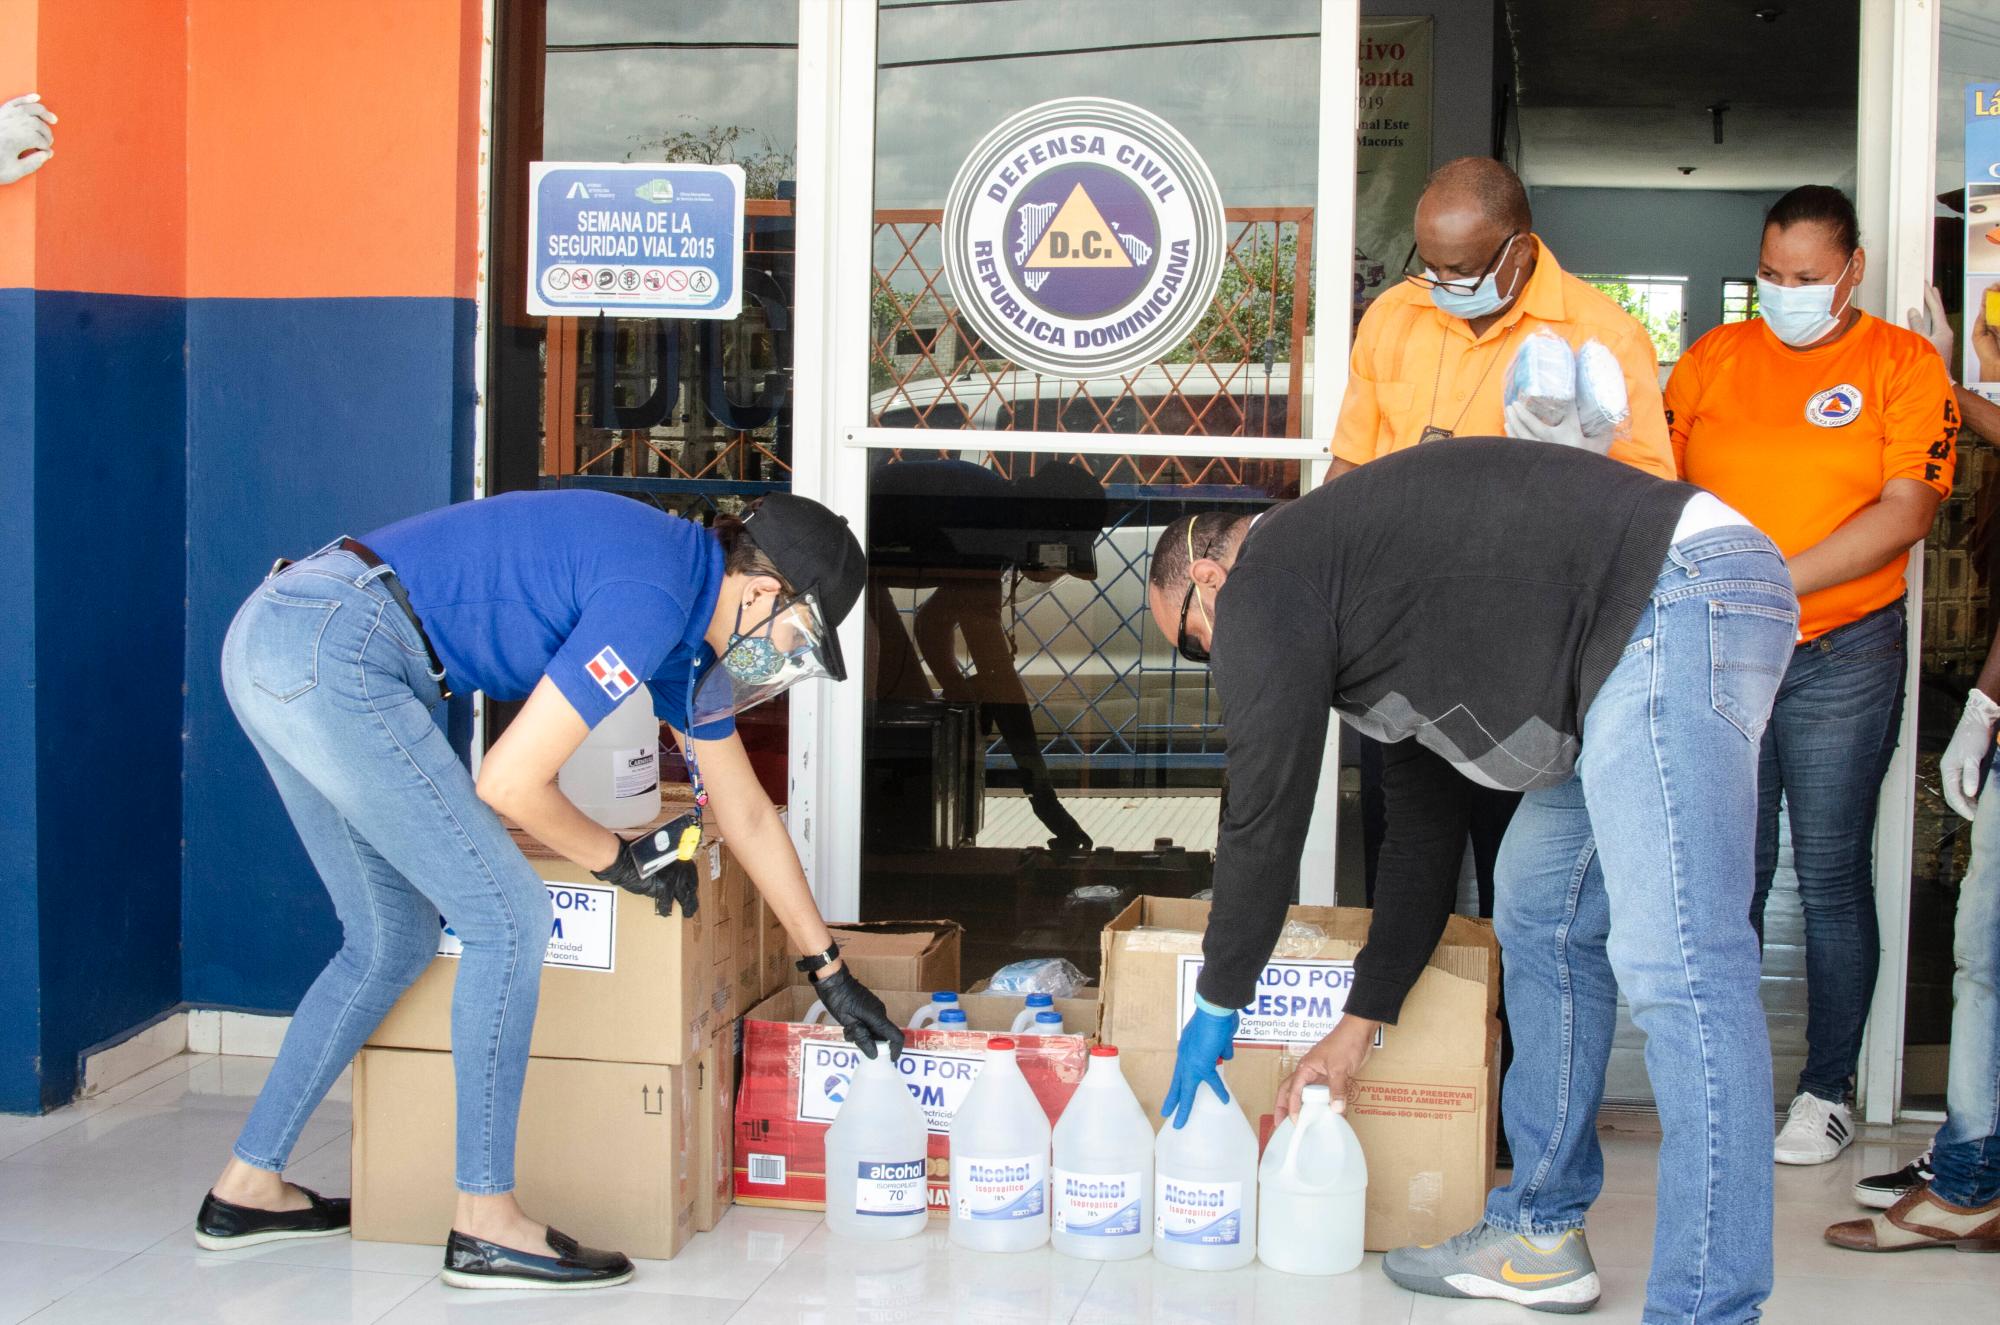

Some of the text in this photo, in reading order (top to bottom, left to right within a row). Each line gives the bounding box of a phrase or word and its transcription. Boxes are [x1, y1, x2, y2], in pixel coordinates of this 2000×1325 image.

[1358, 96, 1384, 111] 019
[1384, 119, 1409, 130] Este
[987, 134, 1176, 204] DEFENSA CIVIL
[577, 211, 692, 234] SEMANA DE LA
[548, 235, 715, 259] SEGURIDAD VIAL 2015
[1049, 230, 1112, 260] D.C.
[975, 239, 1190, 348] REPUBLICA DOMINICANA
[1240, 1027, 1251, 1036] de
[1254, 1028, 1270, 1036] San
[1274, 1028, 1298, 1037] Pedro
[1300, 1029, 1311, 1037] de
[1288, 1020, 1299, 1028] de
[924, 1059, 978, 1081] POR:
[1384, 1095, 1413, 1103] MEDIO
[1415, 1097, 1462, 1106] AMBIENTE
[1420, 1089, 1473, 1100] PRESERVAR
[1354, 1107, 1398, 1117] Certificado
[927, 1118, 950, 1127] Maco
[870, 1161, 922, 1179] alcohol
[969, 1162, 1030, 1183] Alcohol
[1065, 1178, 1125, 1199] Alcohol
[1165, 1184, 1224, 1207] Alcohol
